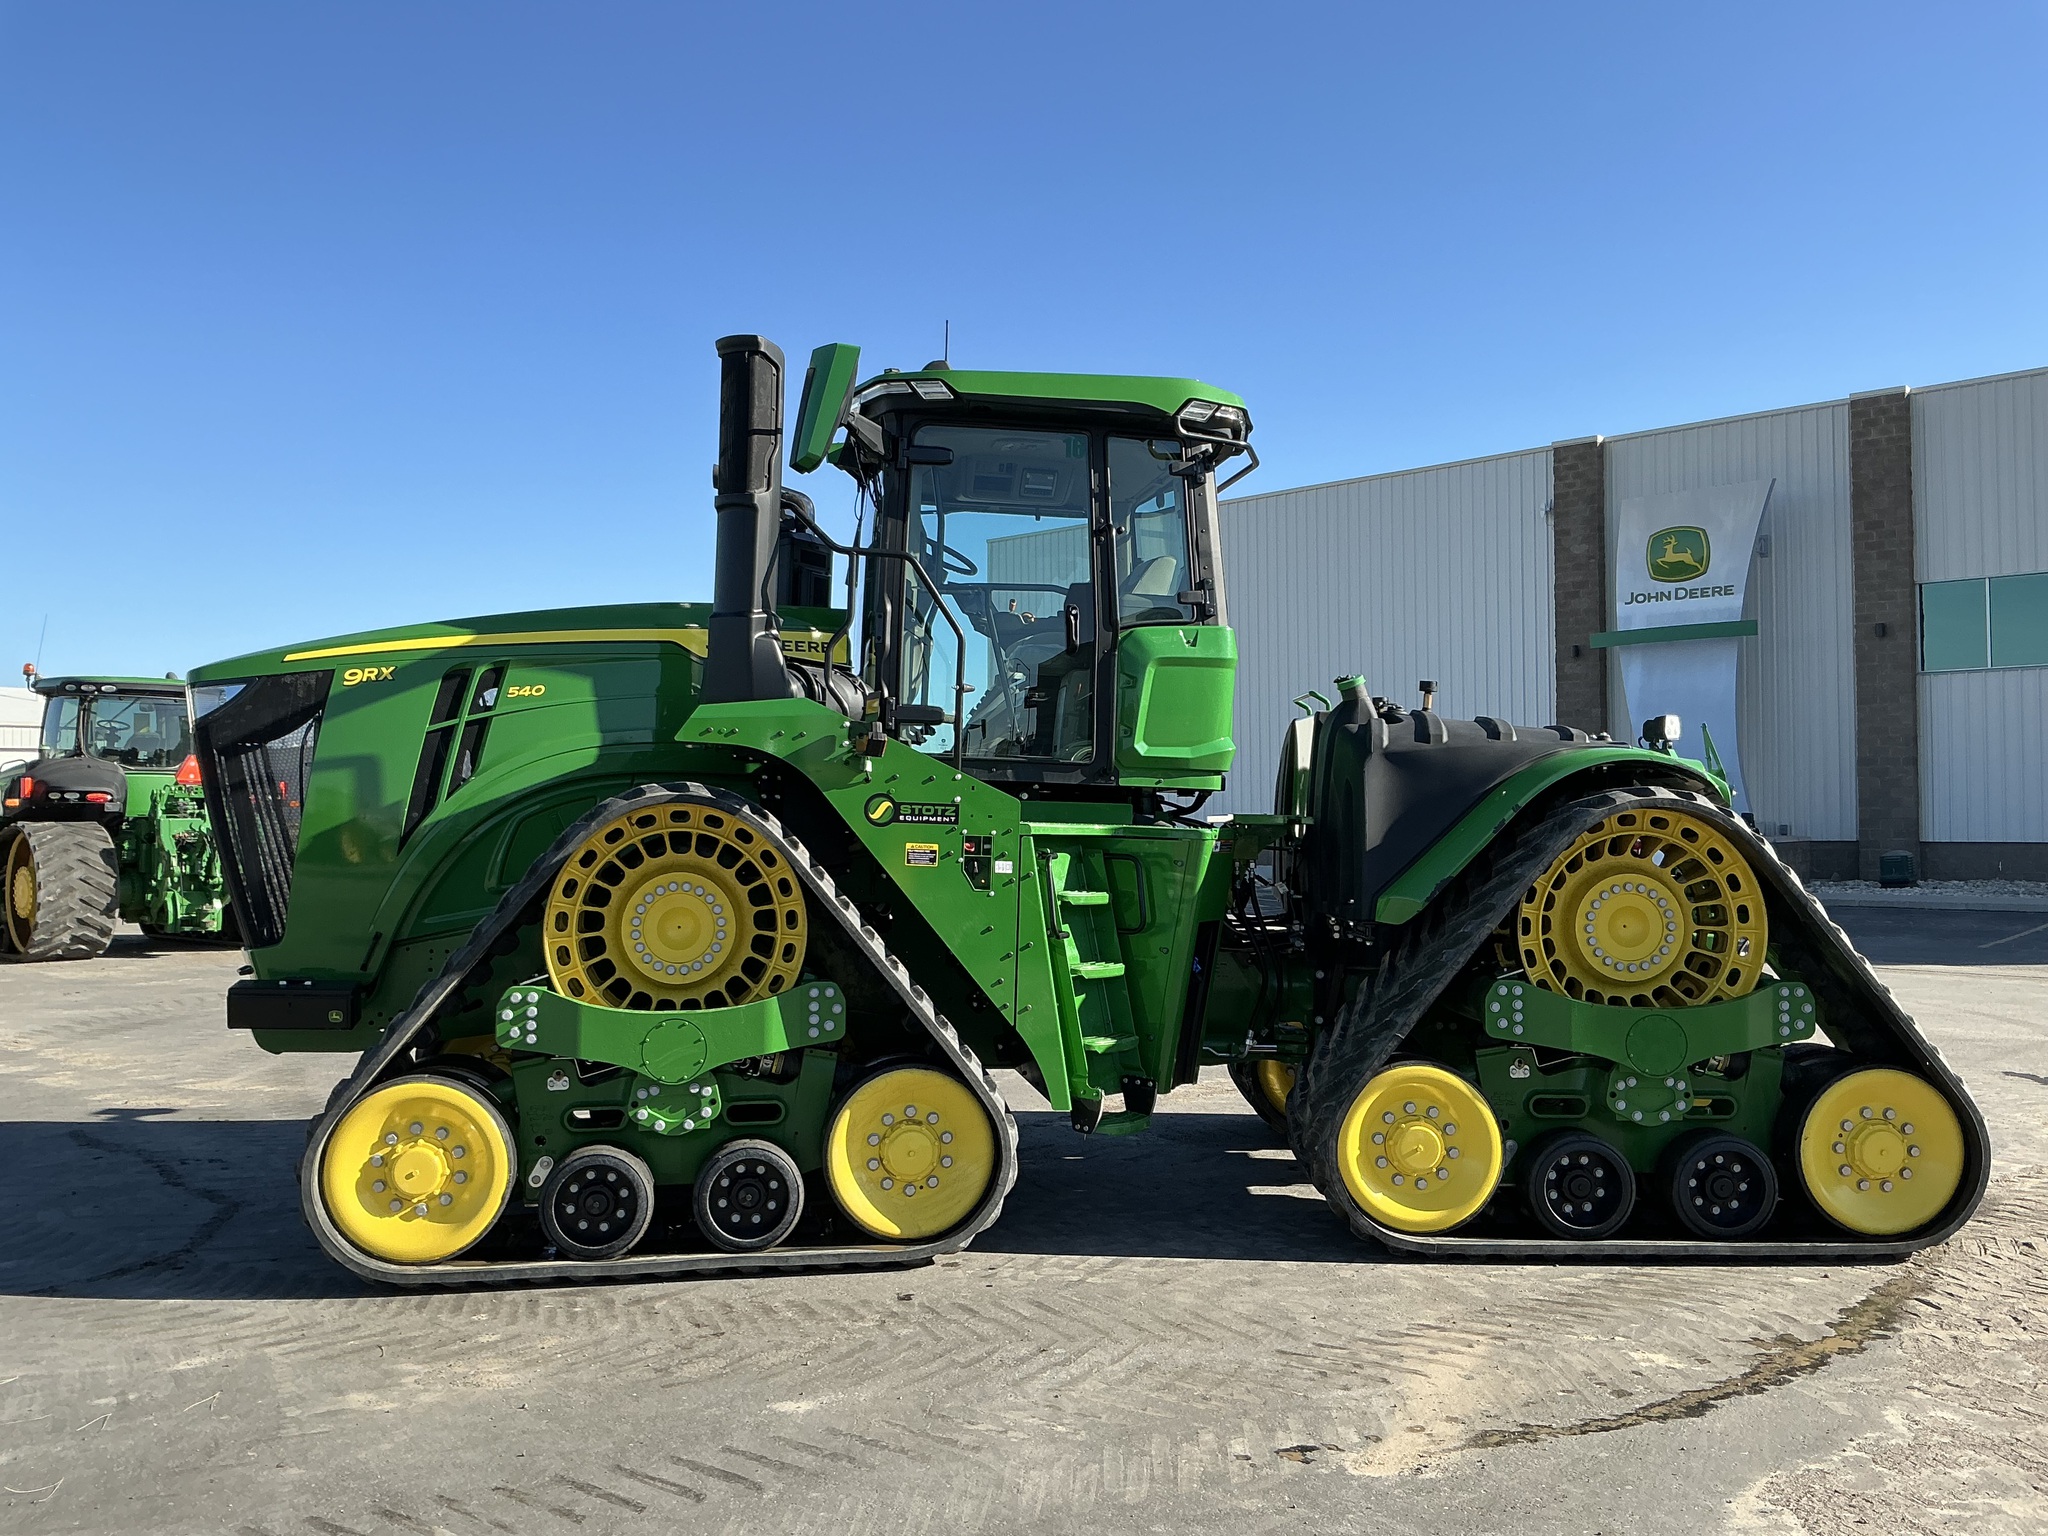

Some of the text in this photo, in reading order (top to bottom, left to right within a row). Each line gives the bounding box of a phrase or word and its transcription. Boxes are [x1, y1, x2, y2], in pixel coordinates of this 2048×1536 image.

[1624, 584, 1735, 605] JOHN DEERE
[343, 665, 397, 687] 9RX
[506, 684, 547, 699] 540
[900, 804, 956, 816] STOTZ
[899, 815, 956, 823] EQUIPMENT
